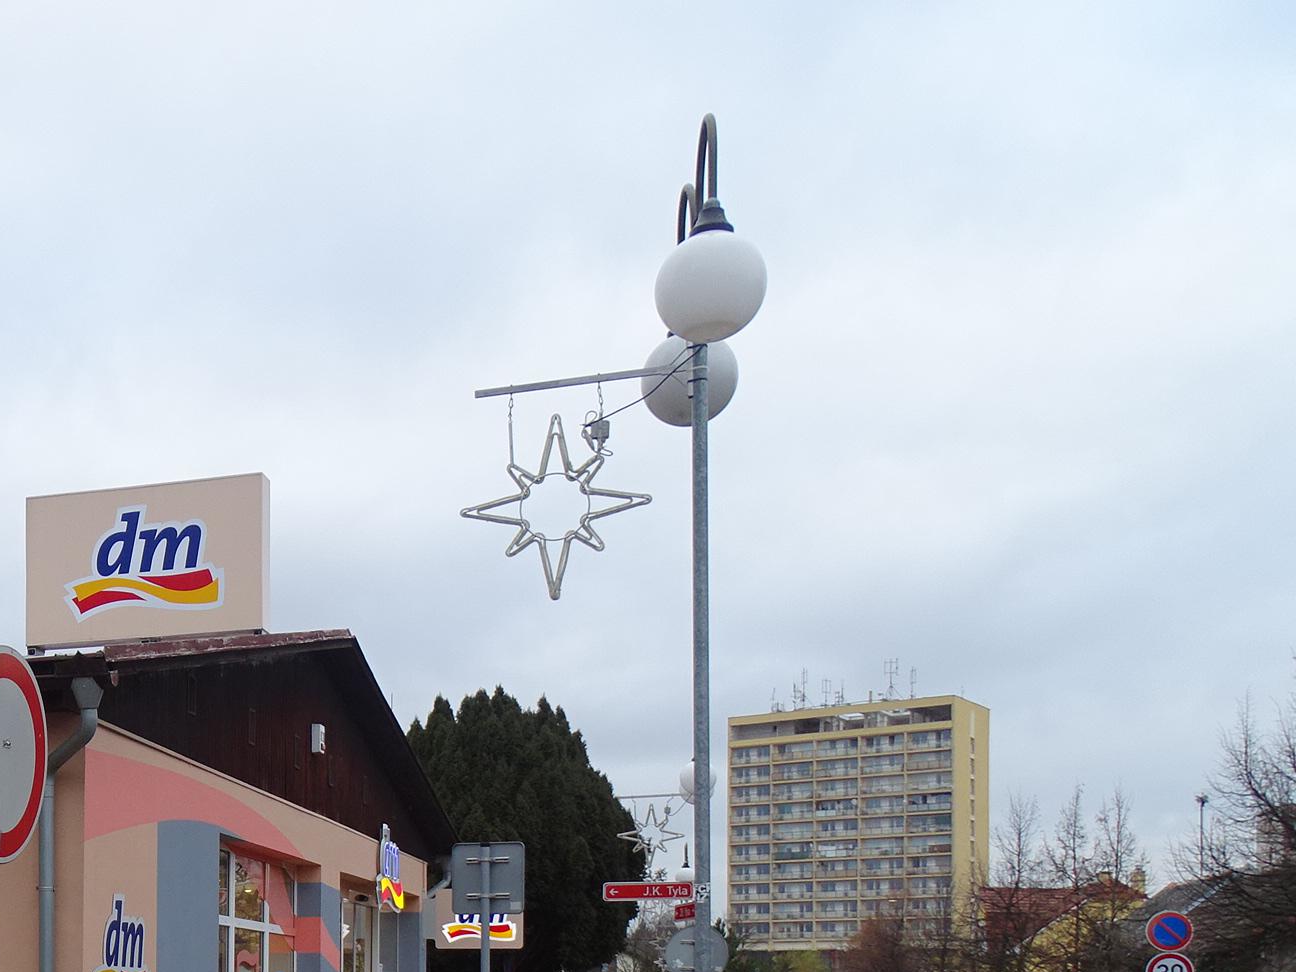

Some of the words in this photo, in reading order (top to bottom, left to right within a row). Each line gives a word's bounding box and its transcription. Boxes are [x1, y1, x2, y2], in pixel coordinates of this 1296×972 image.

[97, 511, 202, 577] dm
[643, 886, 663, 897] J.K.
[667, 886, 689, 898] Tyla
[106, 900, 144, 968] dm
